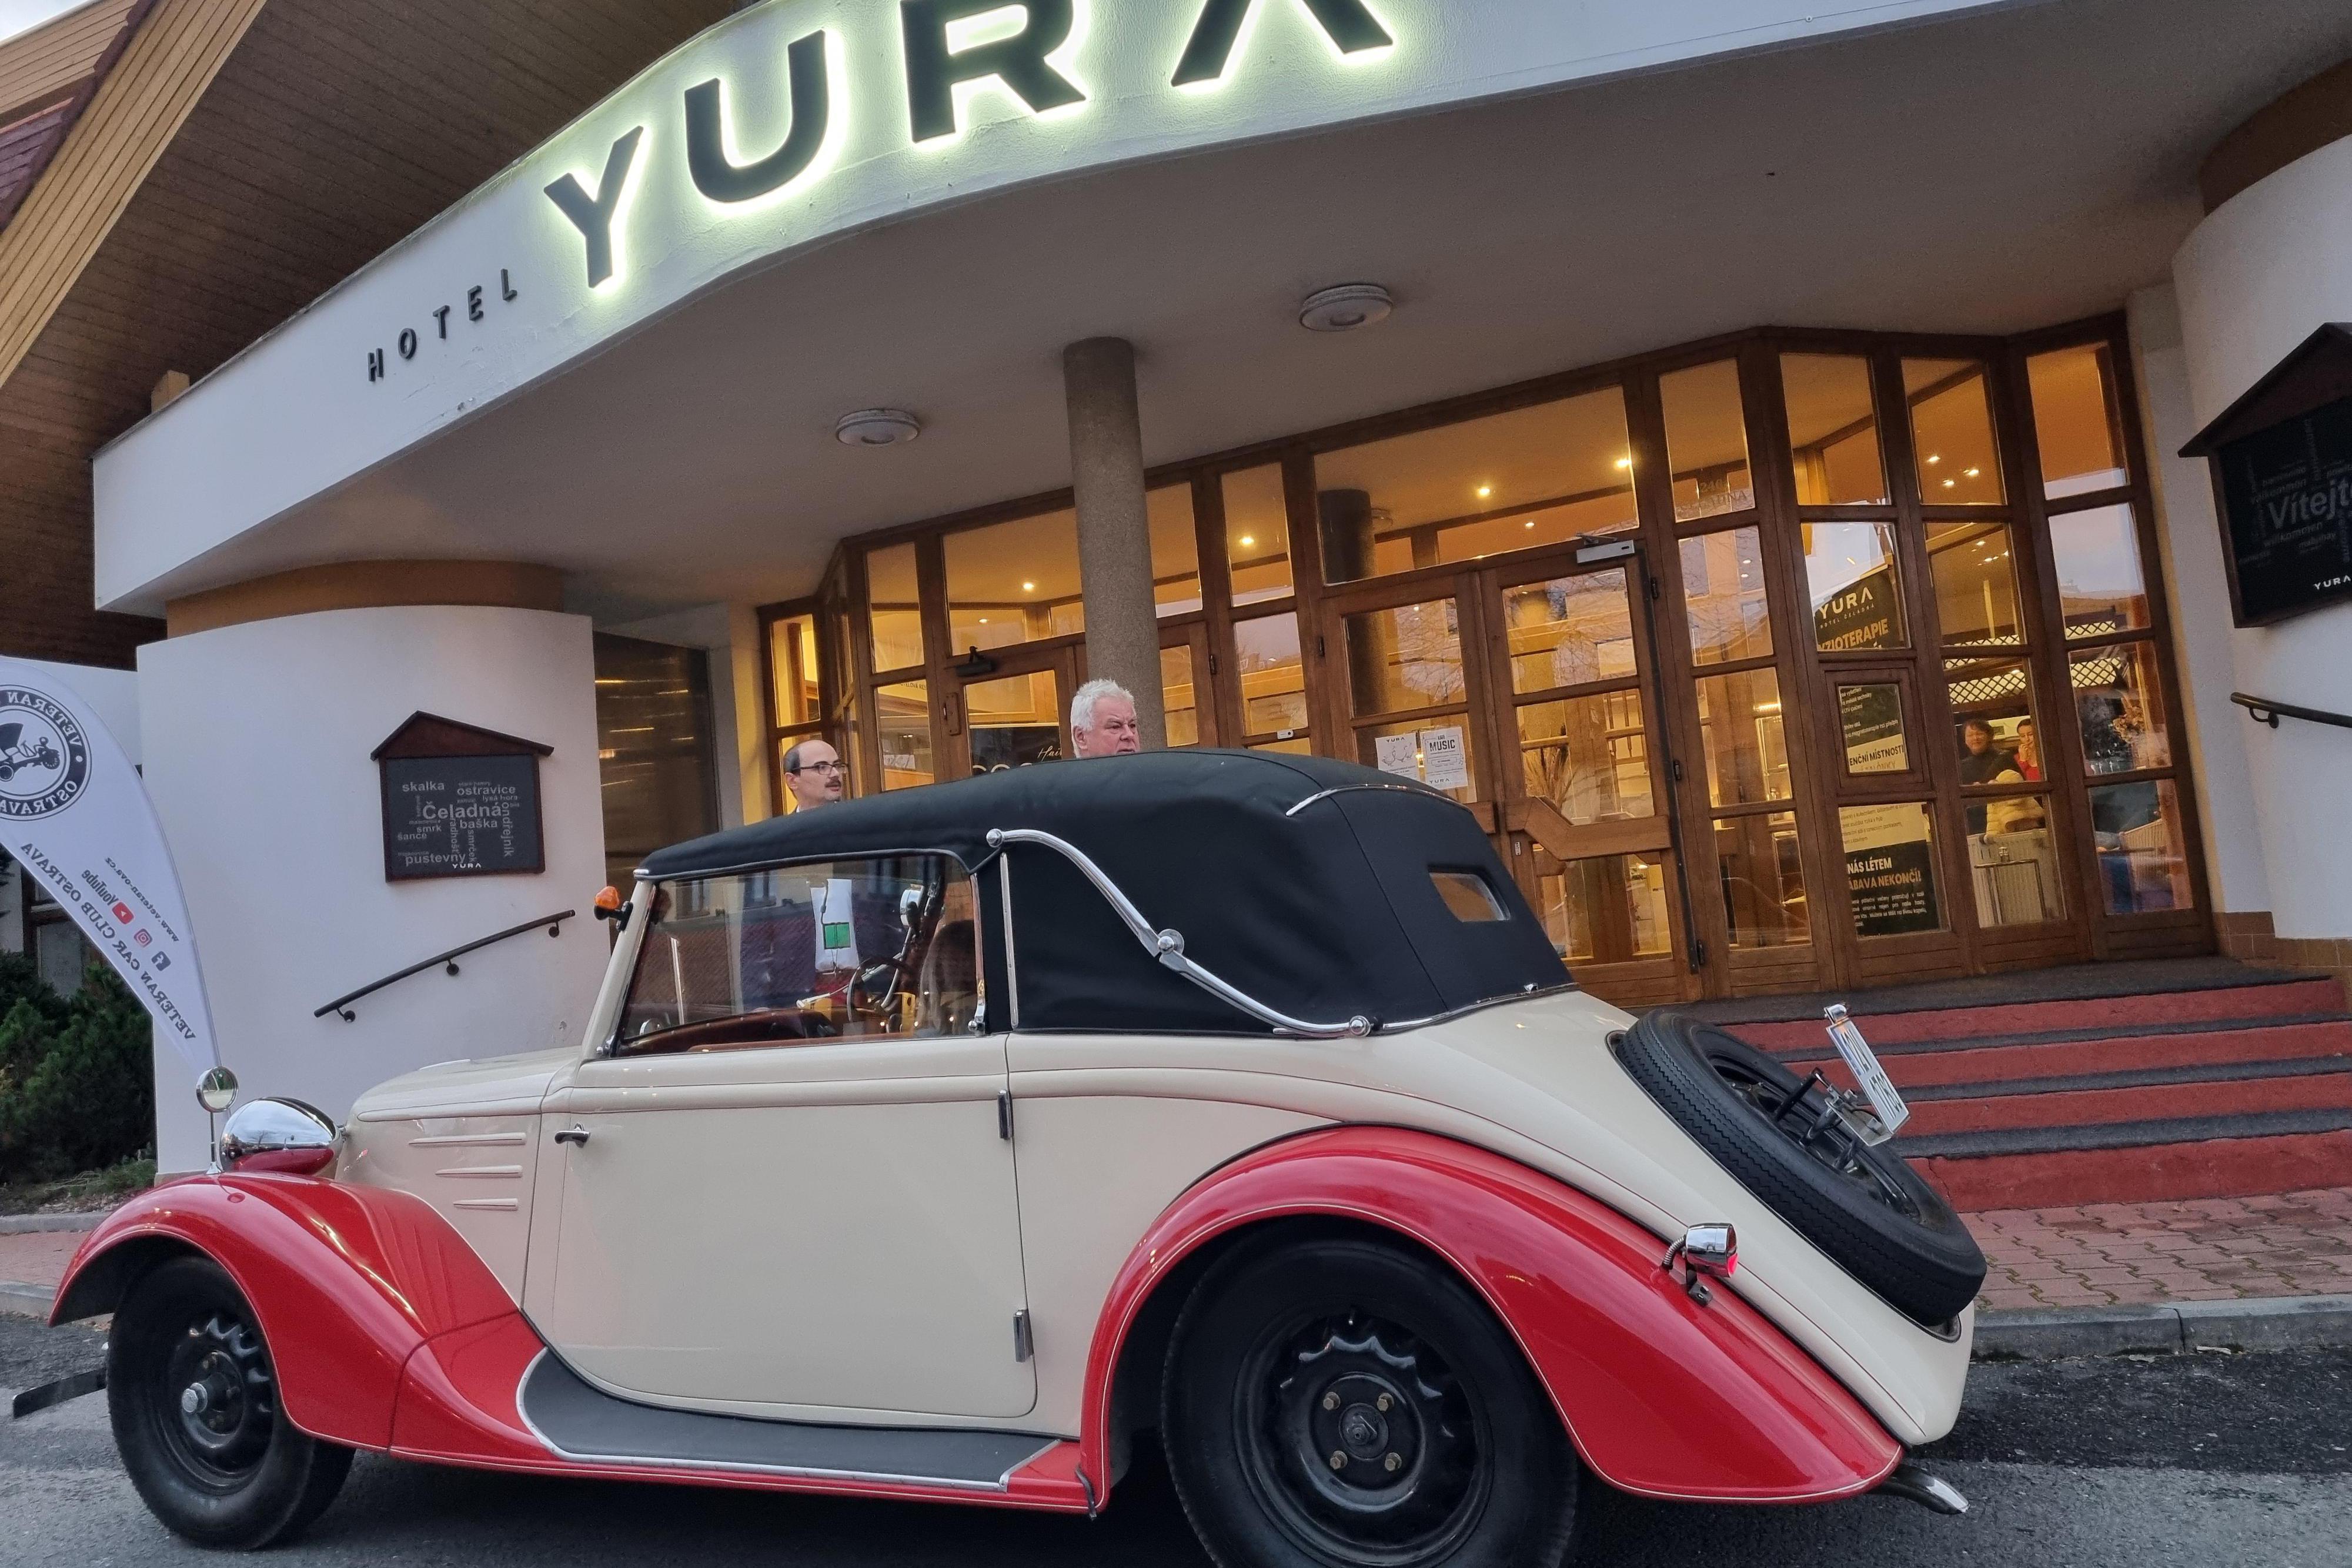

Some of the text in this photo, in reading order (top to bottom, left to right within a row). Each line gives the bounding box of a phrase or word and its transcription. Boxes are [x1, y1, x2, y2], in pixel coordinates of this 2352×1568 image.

[368, 0, 1394, 382] HOTEL YURA
[2267, 477, 2352, 529] Vítejt
[2314, 574, 2351, 590] YURA
[1819, 587, 1873, 620] YURA
[1429, 739, 1455, 752] MUSIC
[402, 781, 445, 792] skalka
[457, 784, 516, 795] ostravice
[422, 801, 502, 820] Čeladná
[416, 824, 442, 833] smrk
[460, 818, 497, 829] baška
[500, 802, 514, 857] ondřejník
[467, 829, 477, 862] smrček
[405, 853, 466, 867] pustevny
[1847, 856, 1892, 875] NÁS LÉTEM
[1877, 867, 1922, 887] NEKONČÍ!
[1868, 1071, 1903, 1119] 1763
